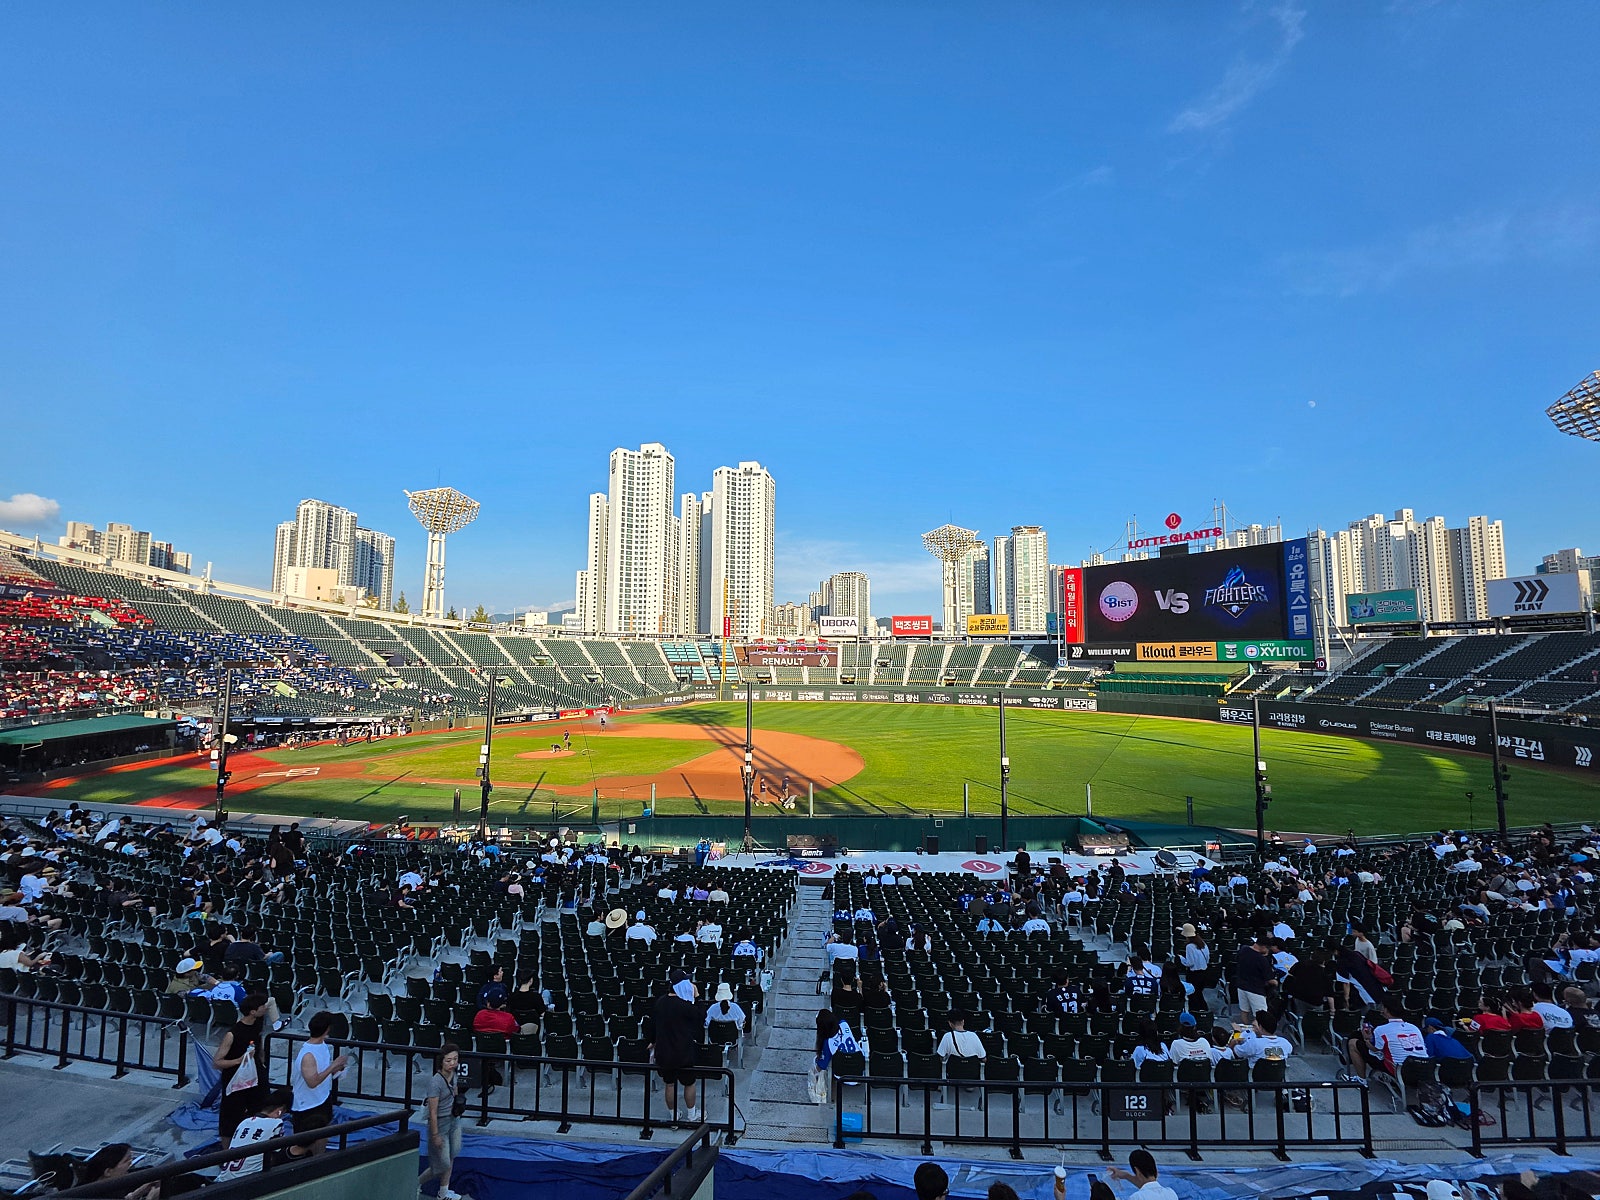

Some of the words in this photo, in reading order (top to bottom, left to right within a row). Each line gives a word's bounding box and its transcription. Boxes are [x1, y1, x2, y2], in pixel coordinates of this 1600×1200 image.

[1128, 536, 1167, 550] LOTTE
[1170, 527, 1222, 542] GIANTS
[1290, 564, 1307, 609] 유록스
[1067, 574, 1076, 628] 롯데월드타워
[1154, 589, 1190, 614] VS
[1204, 586, 1268, 606] FIGHTERS
[1377, 605, 1414, 614] GLASS
[1514, 602, 1543, 612] PLAY
[895, 620, 929, 630] 백조씽크
[1179, 645, 1213, 657] 클라우드
[1260, 646, 1306, 657] XYLITOL
[762, 658, 804, 666] RENAULT
[1316, 660, 1325, 668] 10
[906, 694, 919, 702] 창신
[1269, 712, 1305, 723] 고려용접봉
[1370, 722, 1394, 730] Polestar
[1394, 724, 1414, 732] Busan
[1426, 731, 1442, 740] 대광
[1444, 732, 1477, 746] 로제비앙
[1094, 847, 1116, 855] Giants
[1062, 1001, 1078, 1013] 13
[1125, 1096, 1147, 1109] 123
